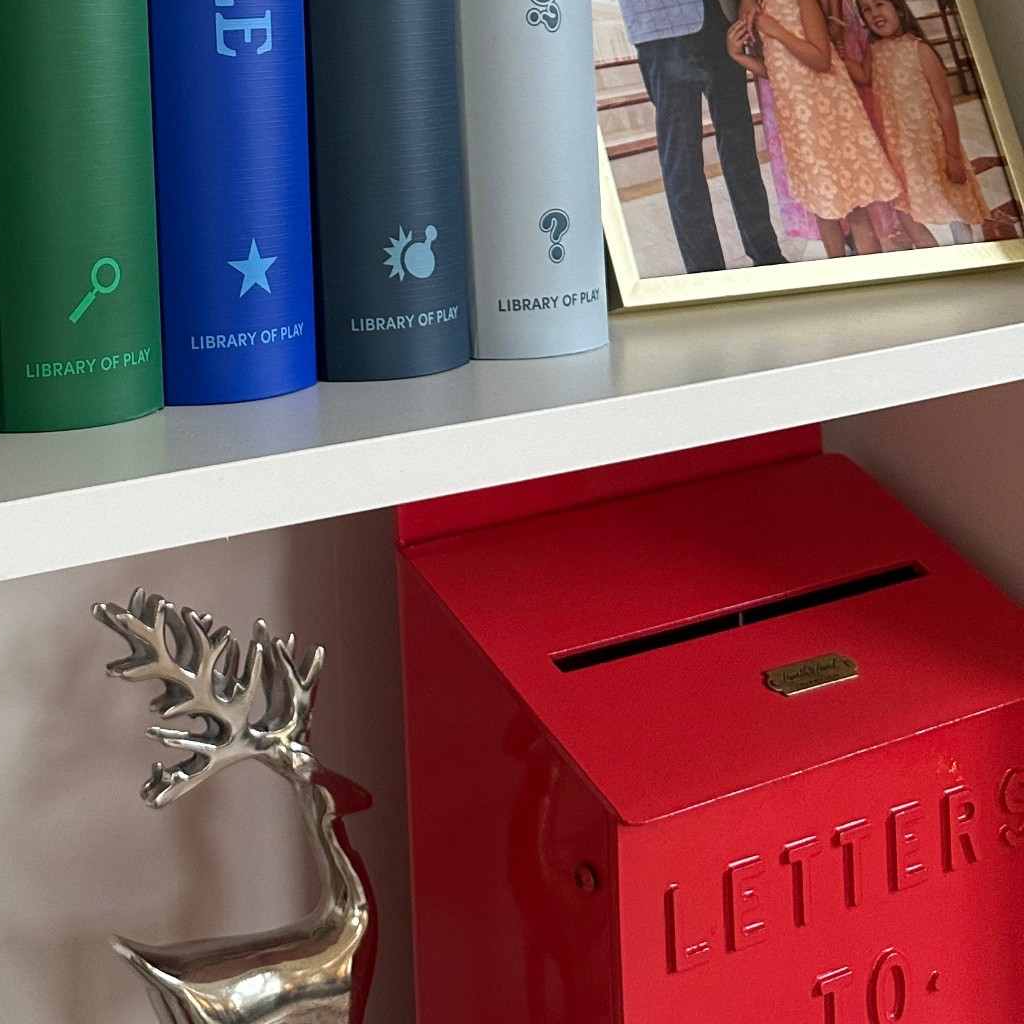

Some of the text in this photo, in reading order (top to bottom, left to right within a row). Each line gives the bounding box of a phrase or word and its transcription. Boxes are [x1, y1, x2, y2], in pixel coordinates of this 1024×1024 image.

[498, 288, 600, 312] LIBRARY OF PLAY
[350, 305, 459, 332] LIBRARY OF PLAY
[190, 321, 304, 350] LIBRARY OF PLAY
[26, 347, 151, 378] LIBRARY OF PLAY
[663, 766, 1024, 975] LETTERS
